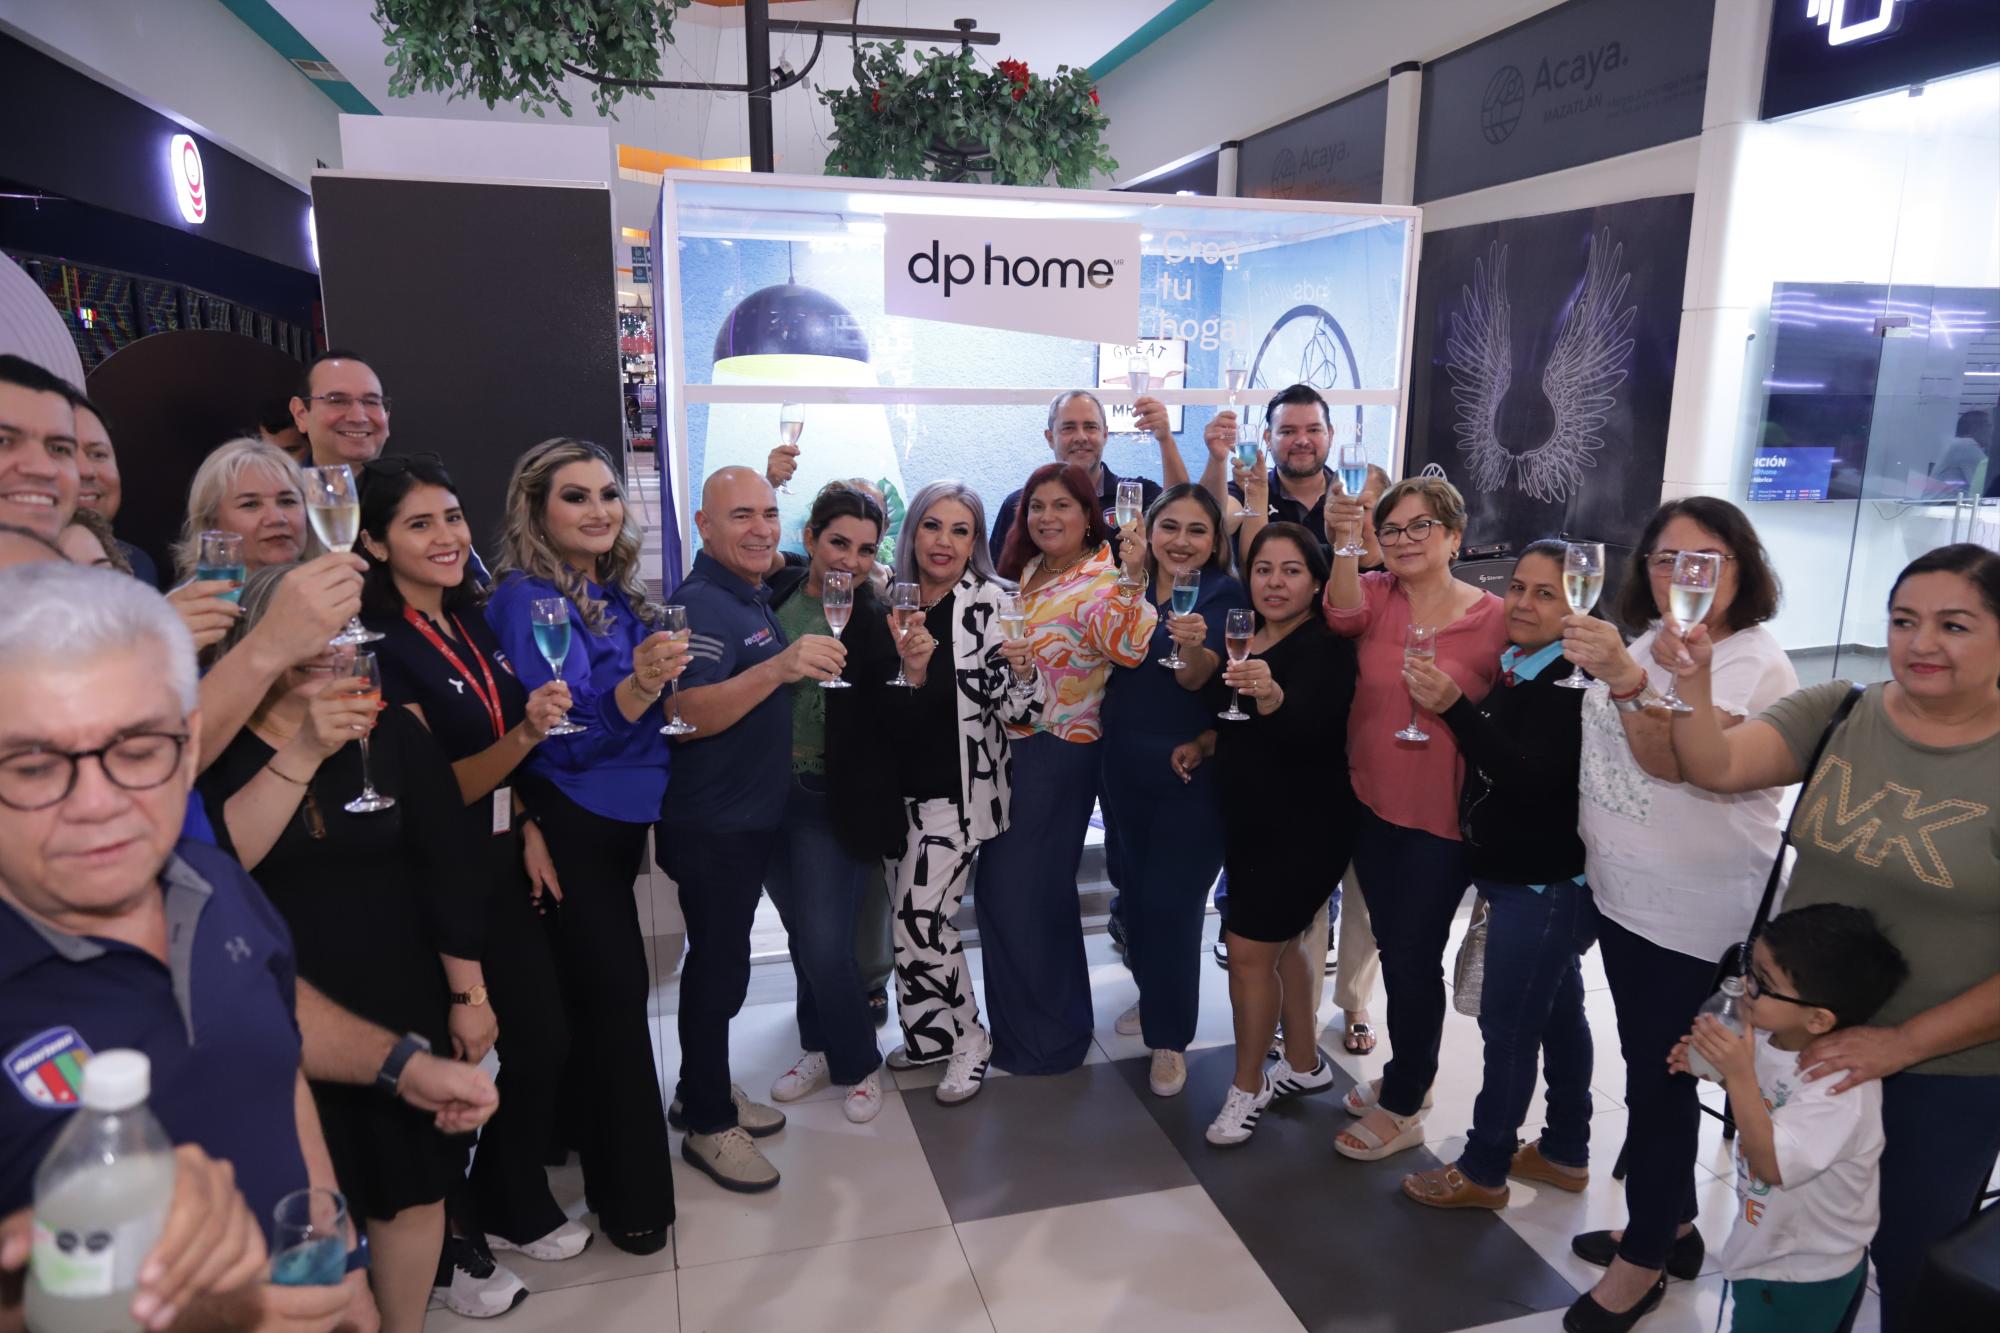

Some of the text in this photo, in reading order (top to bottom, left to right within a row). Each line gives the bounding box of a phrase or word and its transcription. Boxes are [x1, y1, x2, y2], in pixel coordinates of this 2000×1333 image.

[1532, 41, 1629, 97] Acaya.
[908, 239, 975, 298] dp
[984, 241, 1114, 289] home
[1161, 271, 1192, 300] tu
[1113, 341, 1166, 359] GREAT
[1791, 754, 1990, 888] MK
